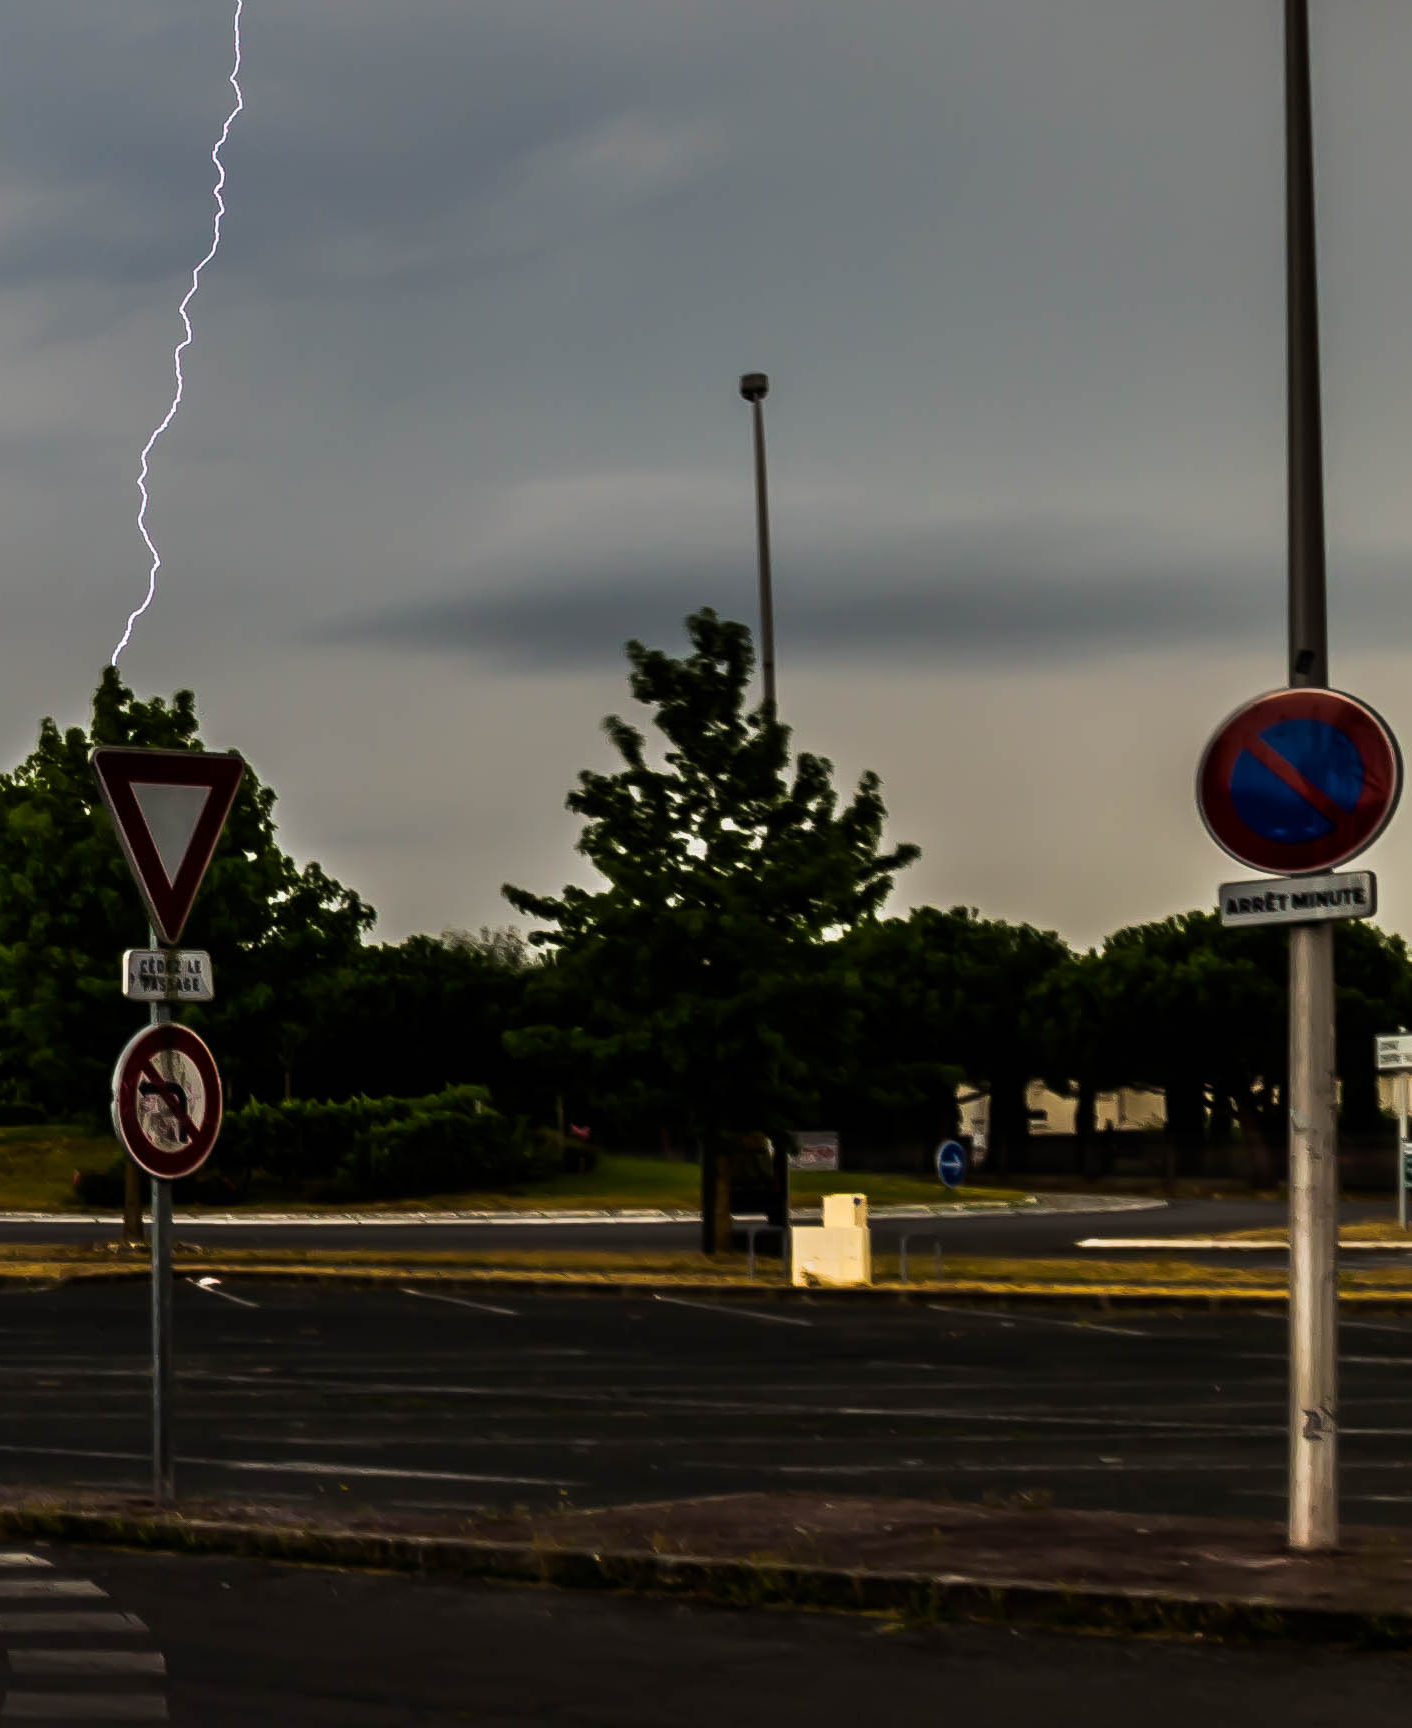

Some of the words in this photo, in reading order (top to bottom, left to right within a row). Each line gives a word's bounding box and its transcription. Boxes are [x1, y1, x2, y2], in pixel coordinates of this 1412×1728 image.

[1227, 891, 1289, 915] ARRÊT
[1291, 887, 1366, 910] MINUTE
[188, 959, 202, 974] LE
[141, 974, 200, 992] PASSAGE
